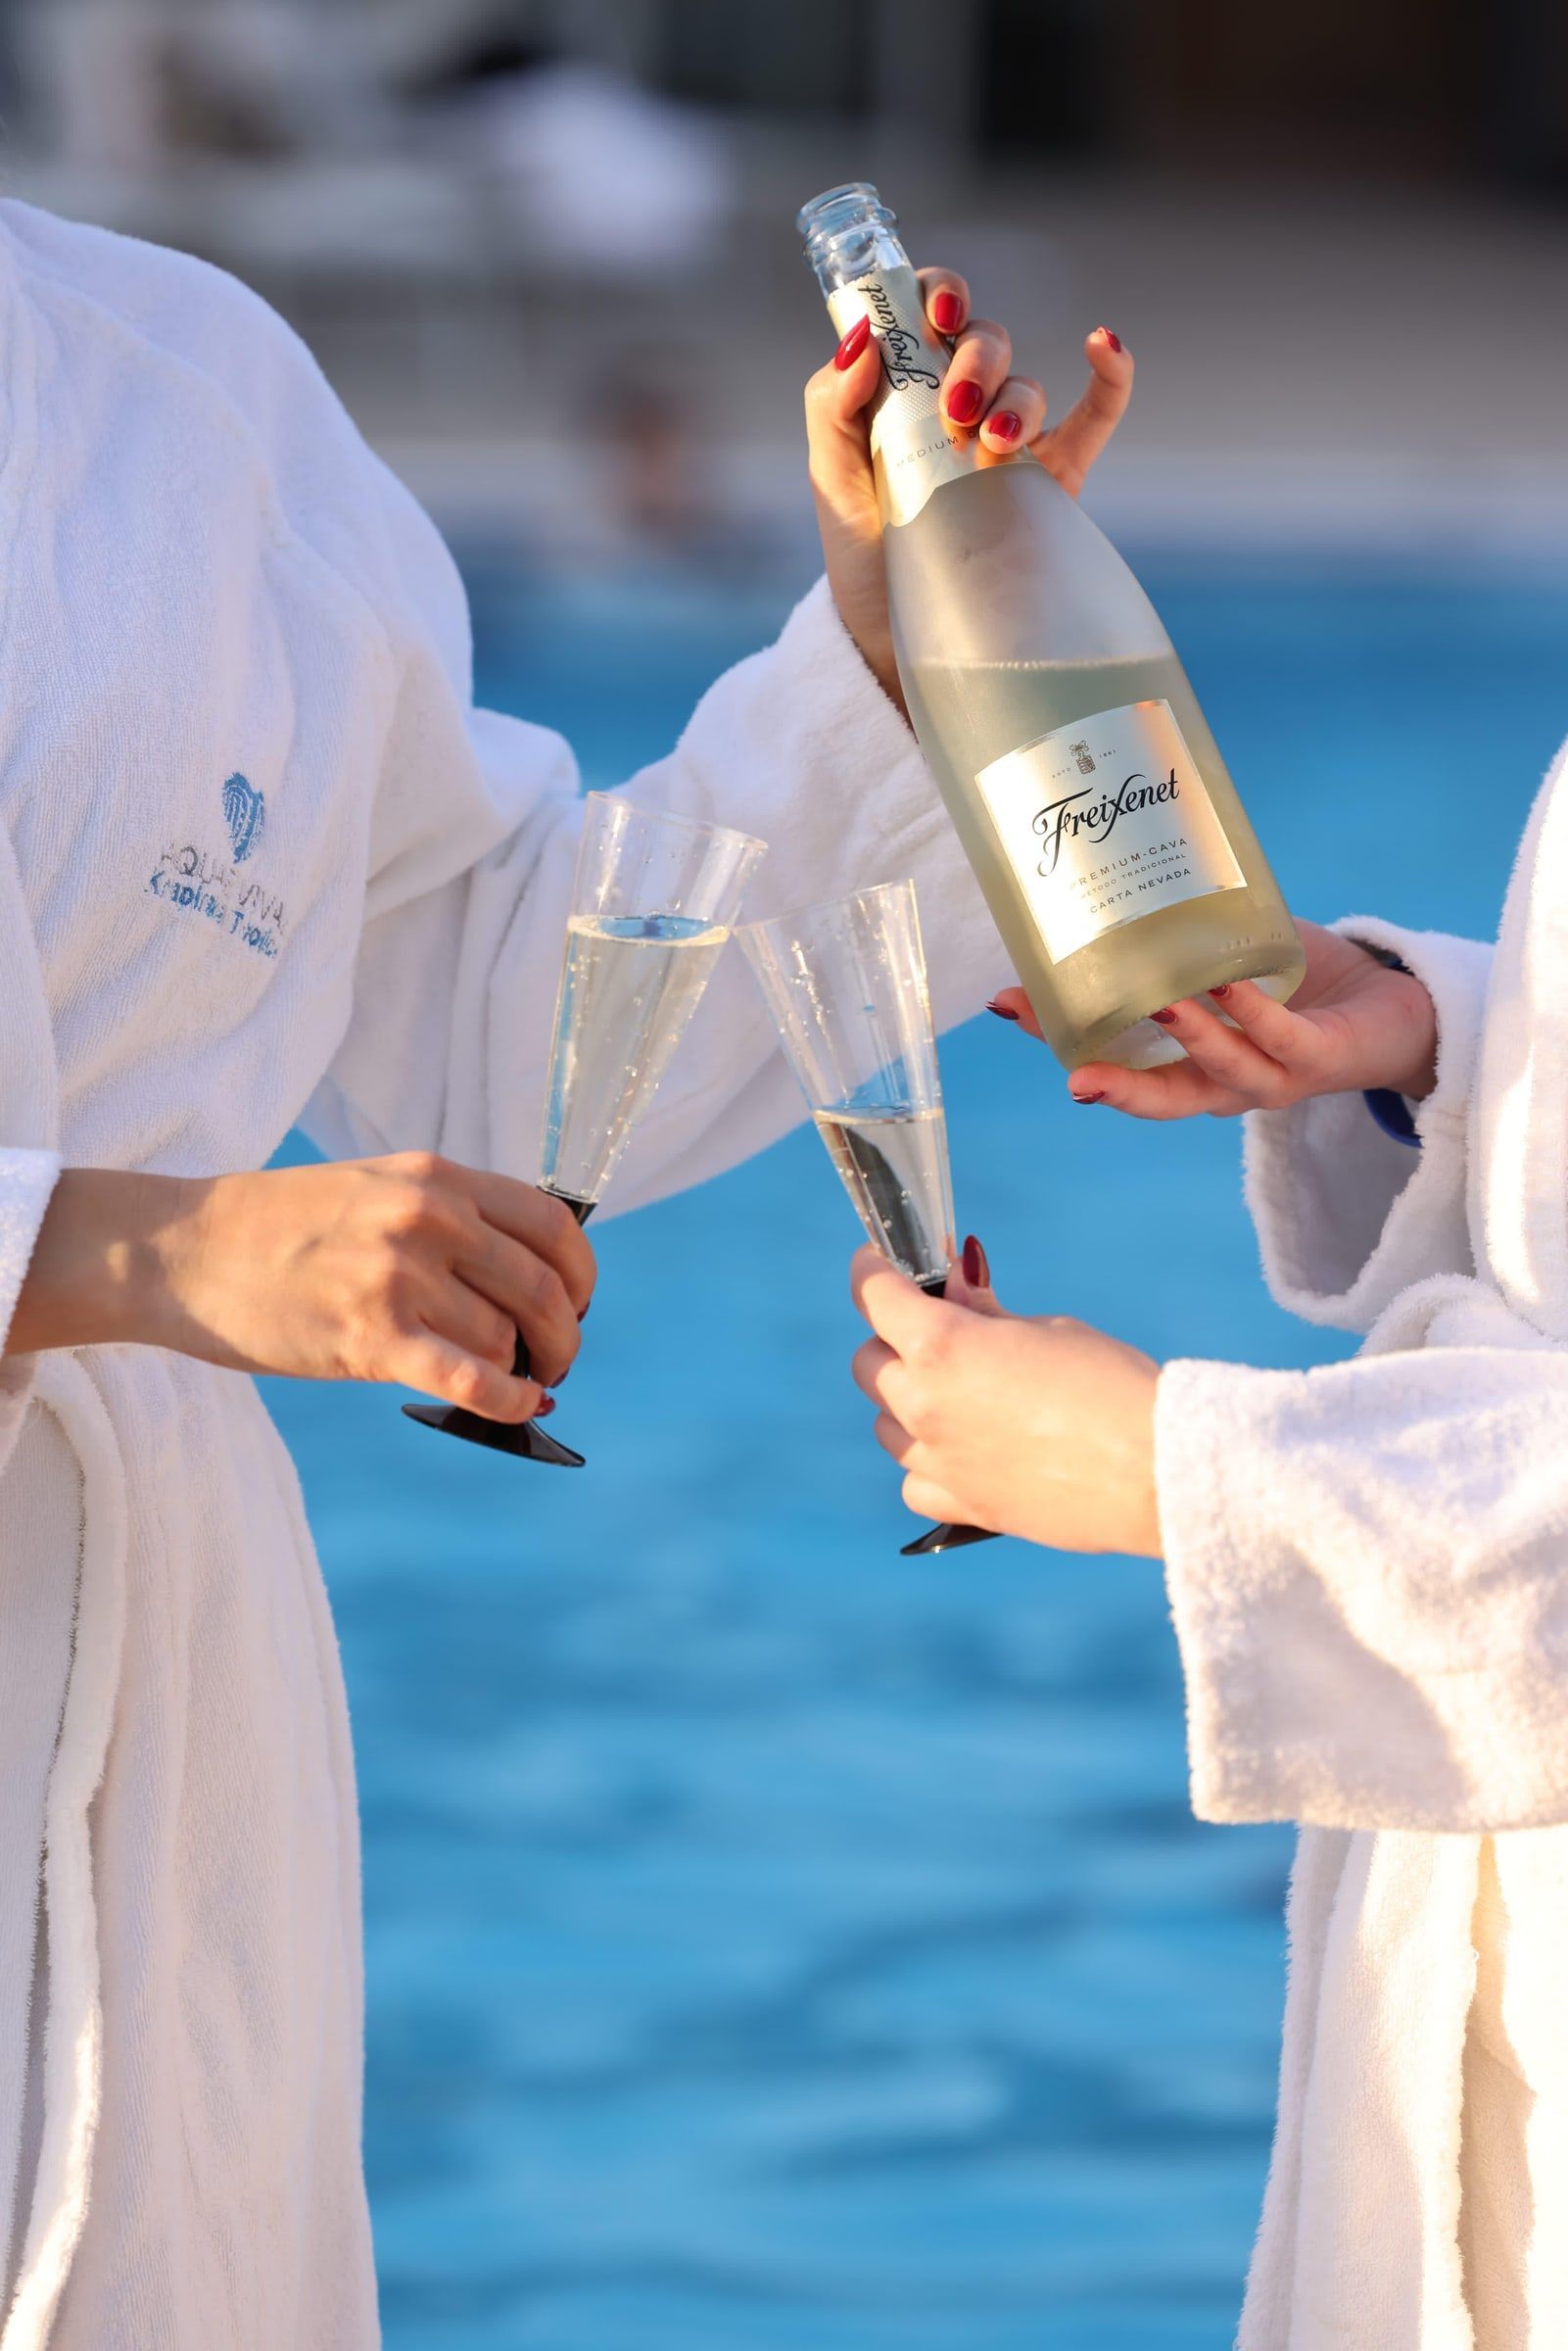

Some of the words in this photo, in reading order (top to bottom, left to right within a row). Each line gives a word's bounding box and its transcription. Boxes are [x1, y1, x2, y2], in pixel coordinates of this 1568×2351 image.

[858, 283, 940, 392] Freixenet
[1031, 767, 1180, 877] Freixenet
[1089, 889, 1133, 914] CARTA
[1138, 868, 1192, 892] NEVADA
[1121, 853, 1187, 880] TRADICIONAL
